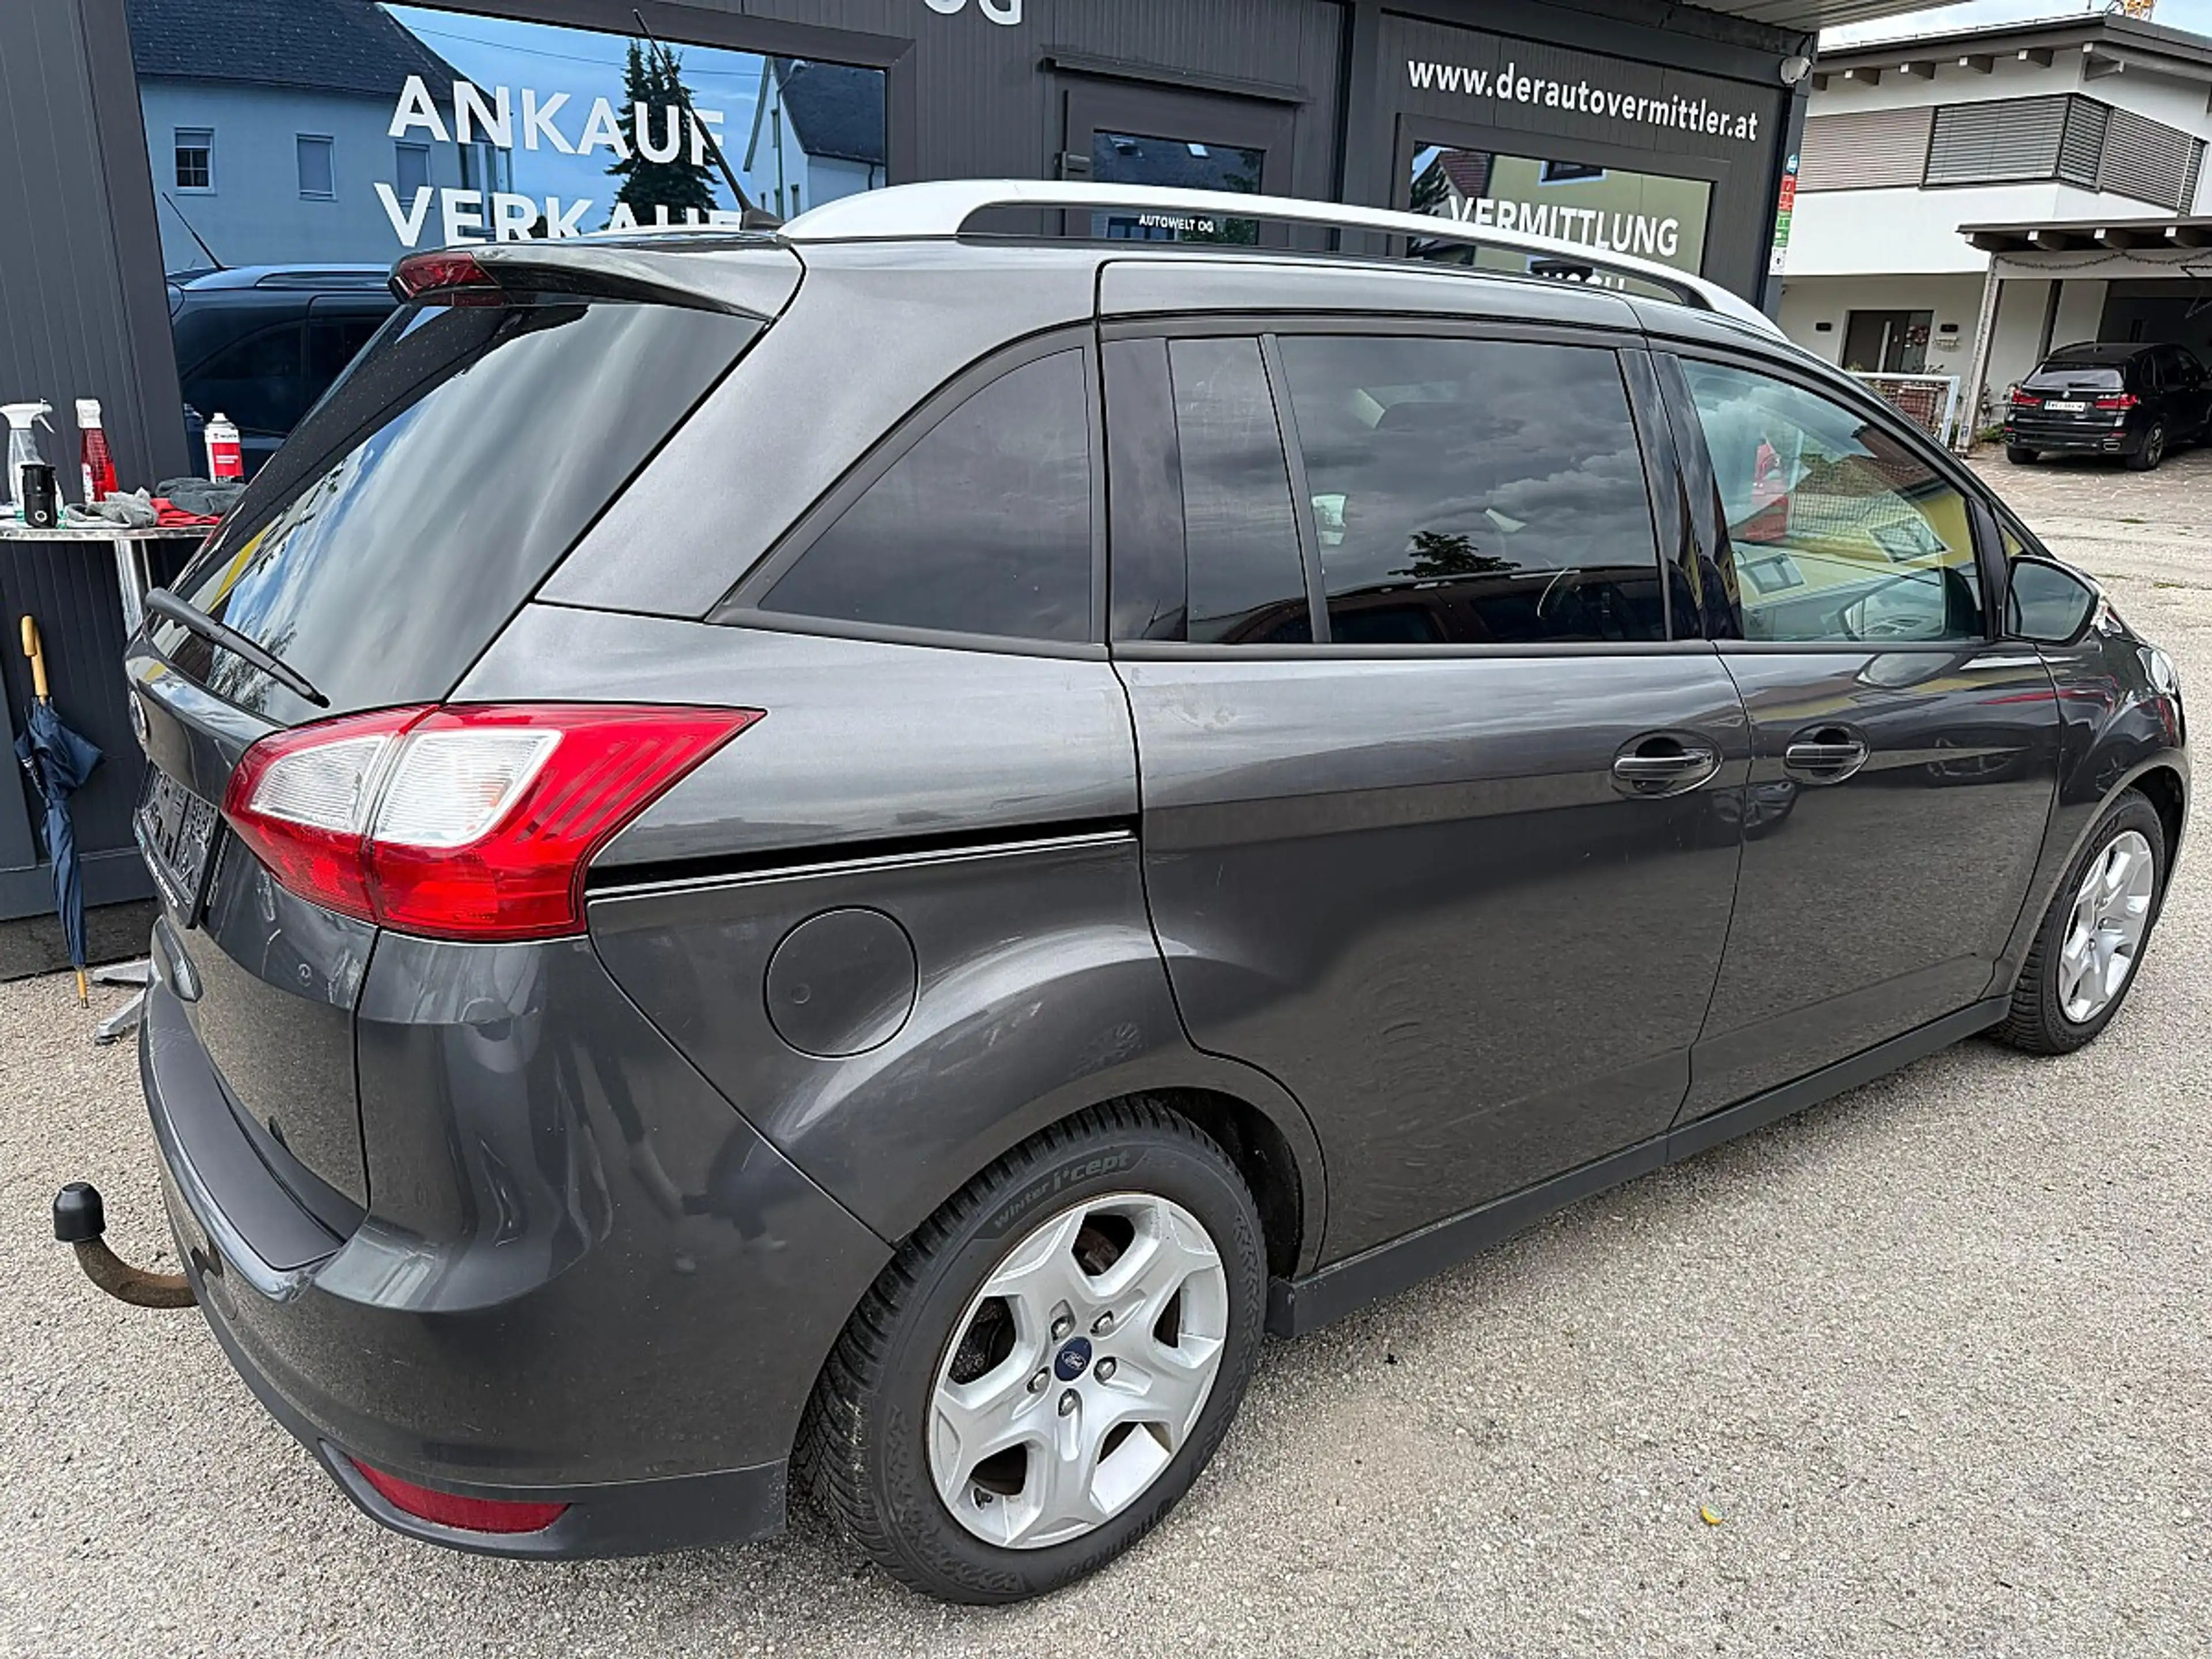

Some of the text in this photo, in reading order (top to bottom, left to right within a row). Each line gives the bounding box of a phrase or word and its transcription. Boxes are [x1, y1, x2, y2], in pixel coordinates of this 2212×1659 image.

[388, 75, 724, 166] ANKAUF
[1407, 60, 1758, 142] www.derautovermittler.at
[374, 182, 742, 248] VERK
[1138, 213, 1214, 233] AUTOWELT OG
[1449, 195, 1679, 257] VERMITTLUNG
